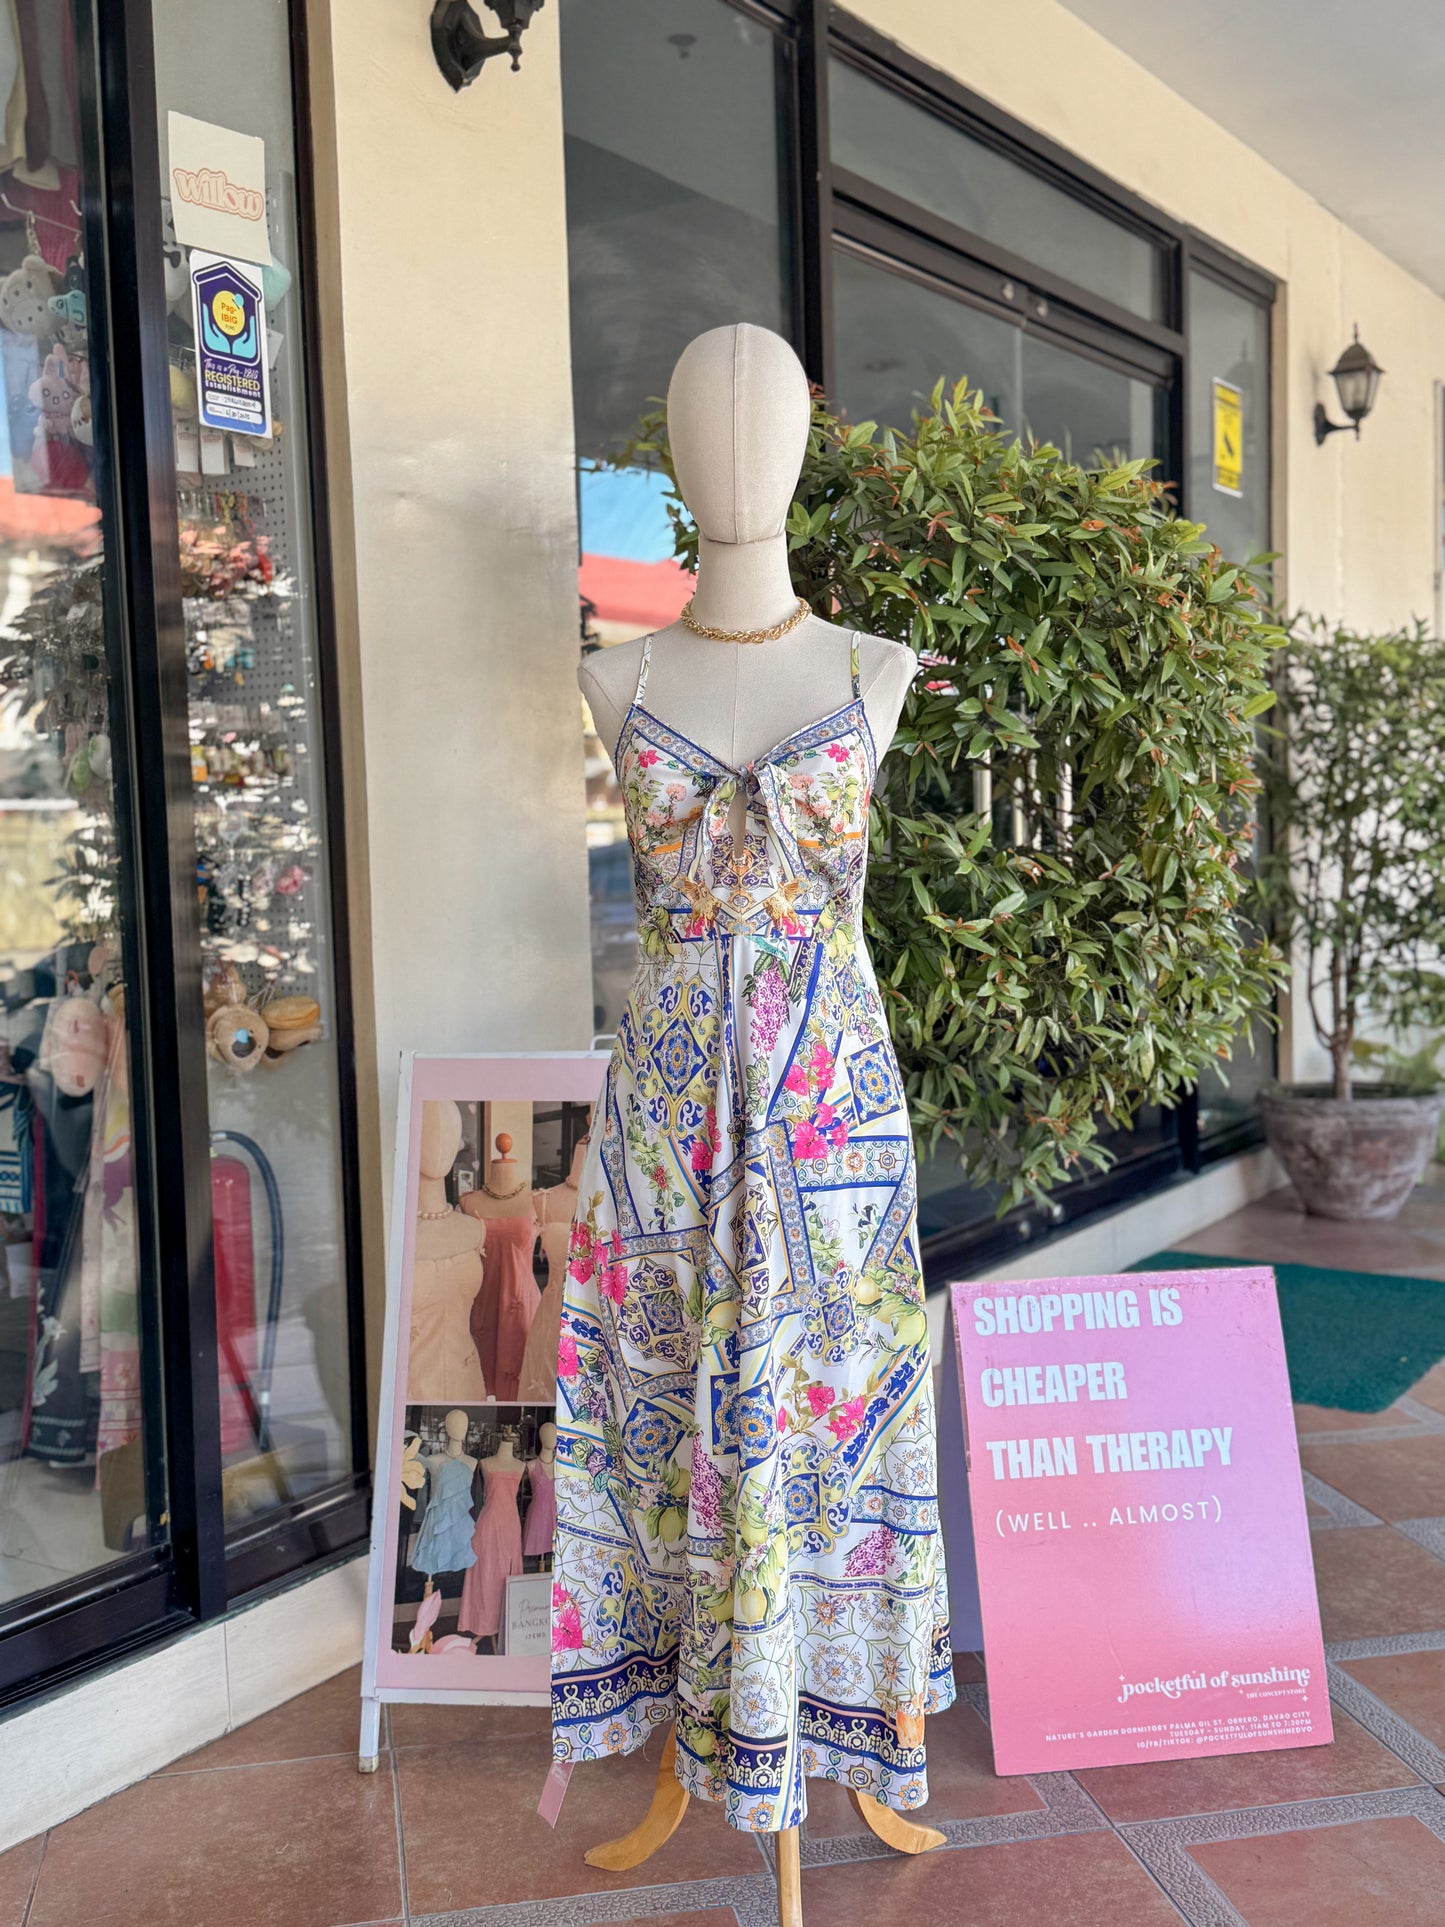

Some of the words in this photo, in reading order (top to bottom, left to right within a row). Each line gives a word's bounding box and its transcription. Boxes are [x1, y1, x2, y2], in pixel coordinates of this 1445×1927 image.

[221, 302, 237, 314] Pag-
[221, 313, 238, 325] IBIG
[205, 370, 260, 391] REGISTERED
[205, 380, 261, 398] Establishment
[973, 1290, 1140, 1336] SHOPPING
[1149, 1287, 1183, 1326] IS
[980, 1361, 1128, 1408] CHEAPER
[986, 1436, 1078, 1481] THAN
[1085, 1427, 1233, 1475] THERAPY
[996, 1509, 1072, 1537] (WELL
[1109, 1495, 1222, 1526] ALMOST)
[1117, 1673, 1207, 1703] pocketful
[1210, 1671, 1229, 1688] of
[1231, 1666, 1311, 1688] sunshine
[1046, 1732, 1085, 1741] NATURE'S
[1087, 1729, 1119, 1738] GARDEN
[1121, 1725, 1168, 1735] DORMITORY
[1170, 1721, 1196, 1730] PALMA
[1212, 1719, 1225, 1727] ST.
[1263, 1713, 1290, 1722] DAVAO
[1292, 1711, 1311, 1719] CITY
[1137, 1737, 1194, 1749] IG/FB/TIKTOK:
[1196, 1726, 1312, 1744] @POCKETFULOFSUNSHINEDVO
[1170, 1728, 1205, 1738] TUESDAY
[1251, 1722, 1269, 1730] 11AM
[1284, 1718, 1311, 1727] 7:30PM
